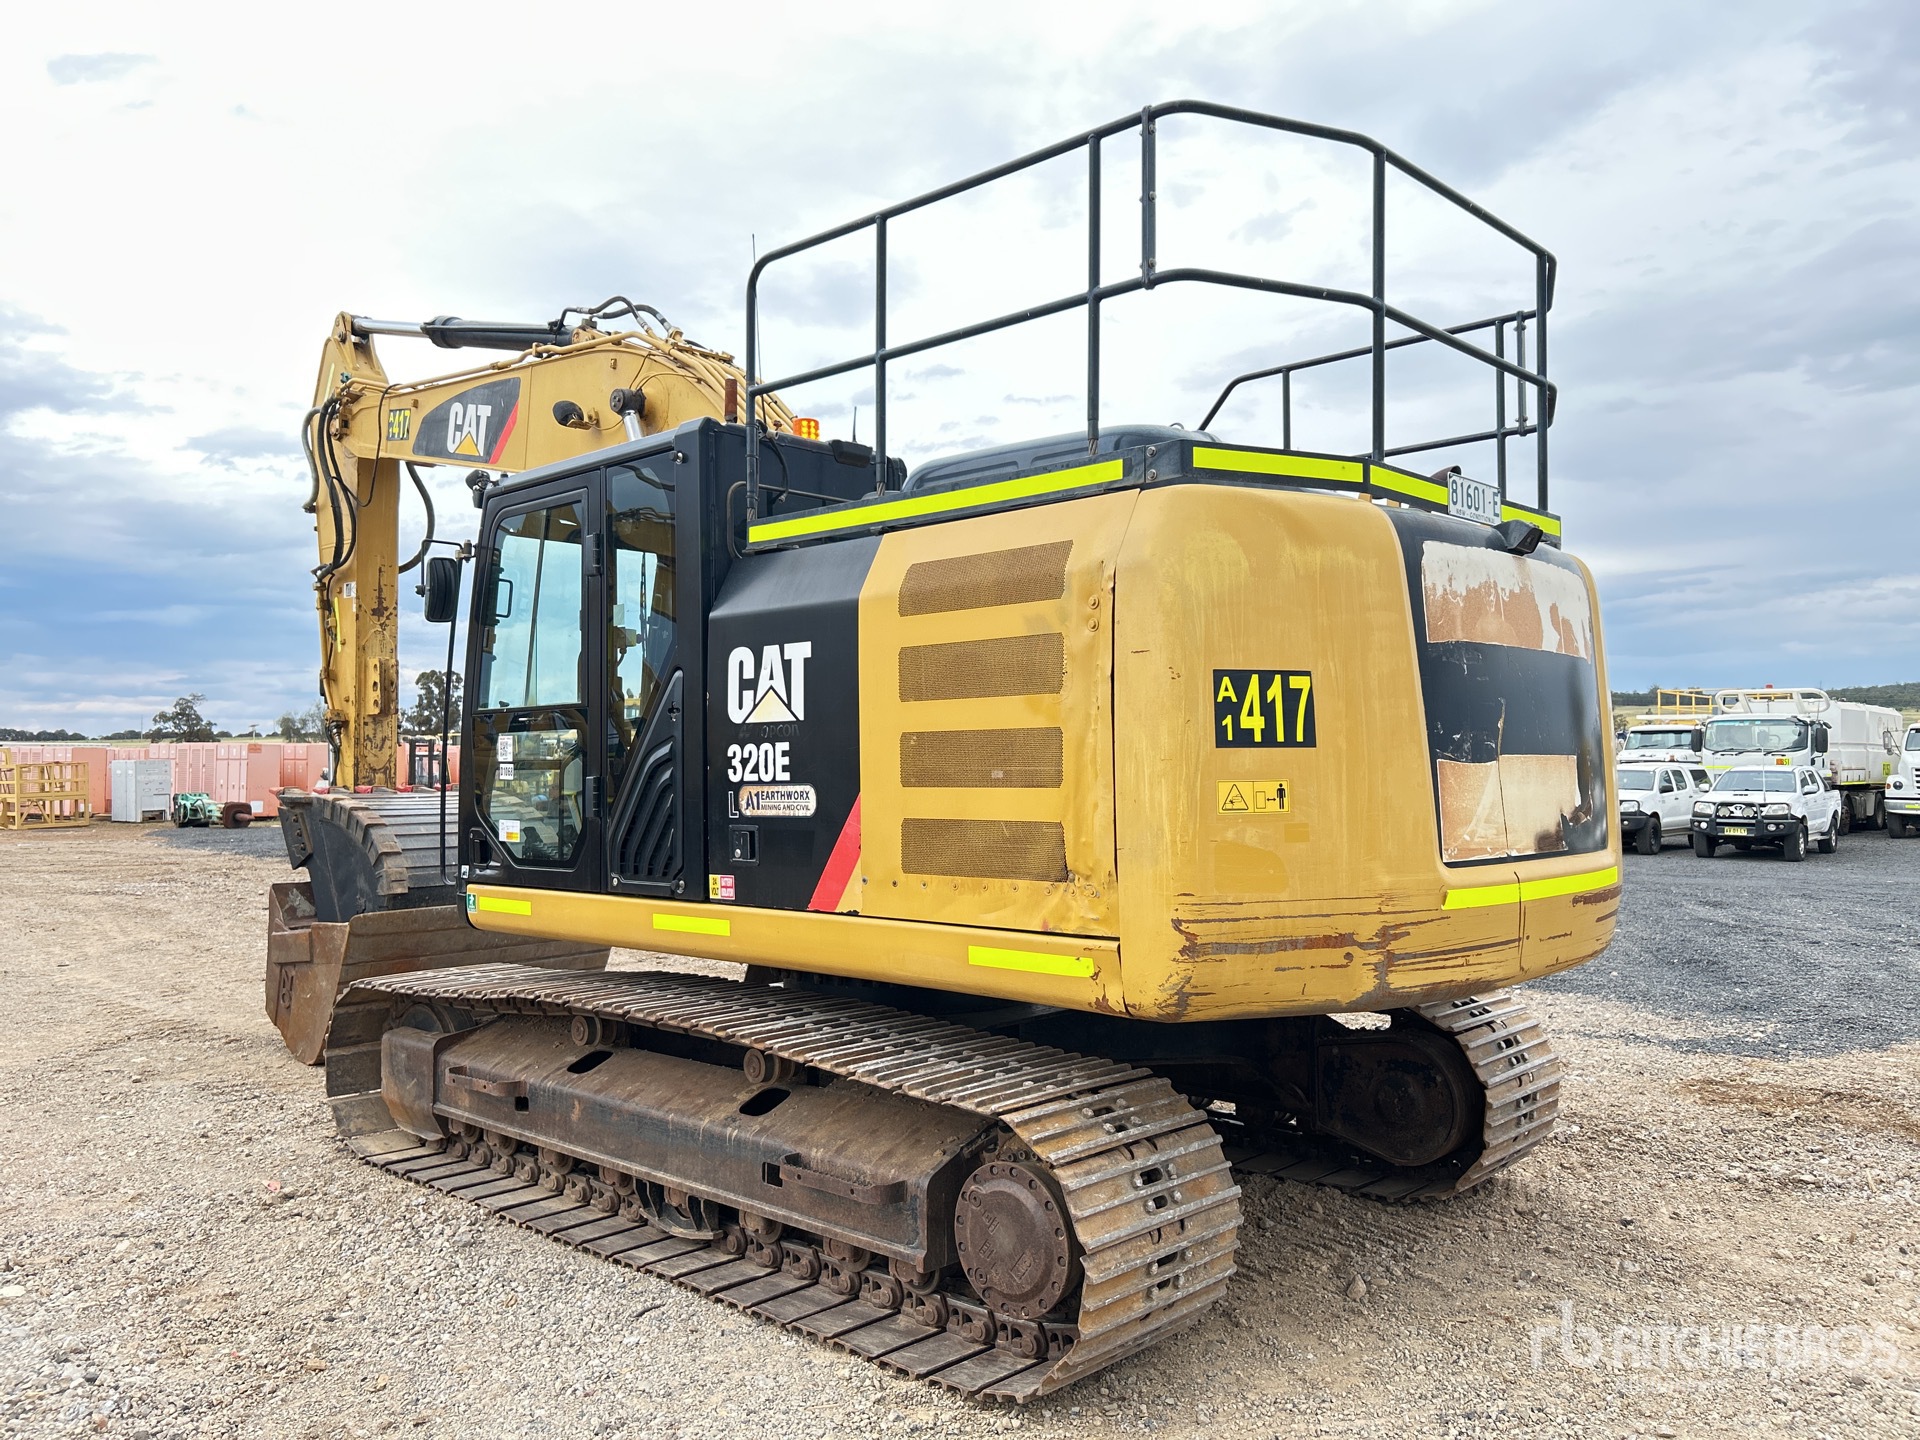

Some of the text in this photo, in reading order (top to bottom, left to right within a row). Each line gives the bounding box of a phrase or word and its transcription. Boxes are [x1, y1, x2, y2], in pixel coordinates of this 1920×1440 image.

[393, 410, 411, 438] 417
[446, 402, 492, 456] CAT
[1451, 479, 1499, 517] 81601-E
[727, 640, 812, 724] CAT
[1239, 673, 1311, 743] 417
[727, 741, 791, 783] 320E
[728, 790, 740, 818] L
[745, 790, 810, 811] A1 EARTHWORX
[795, 803, 811, 812] CIVIL
